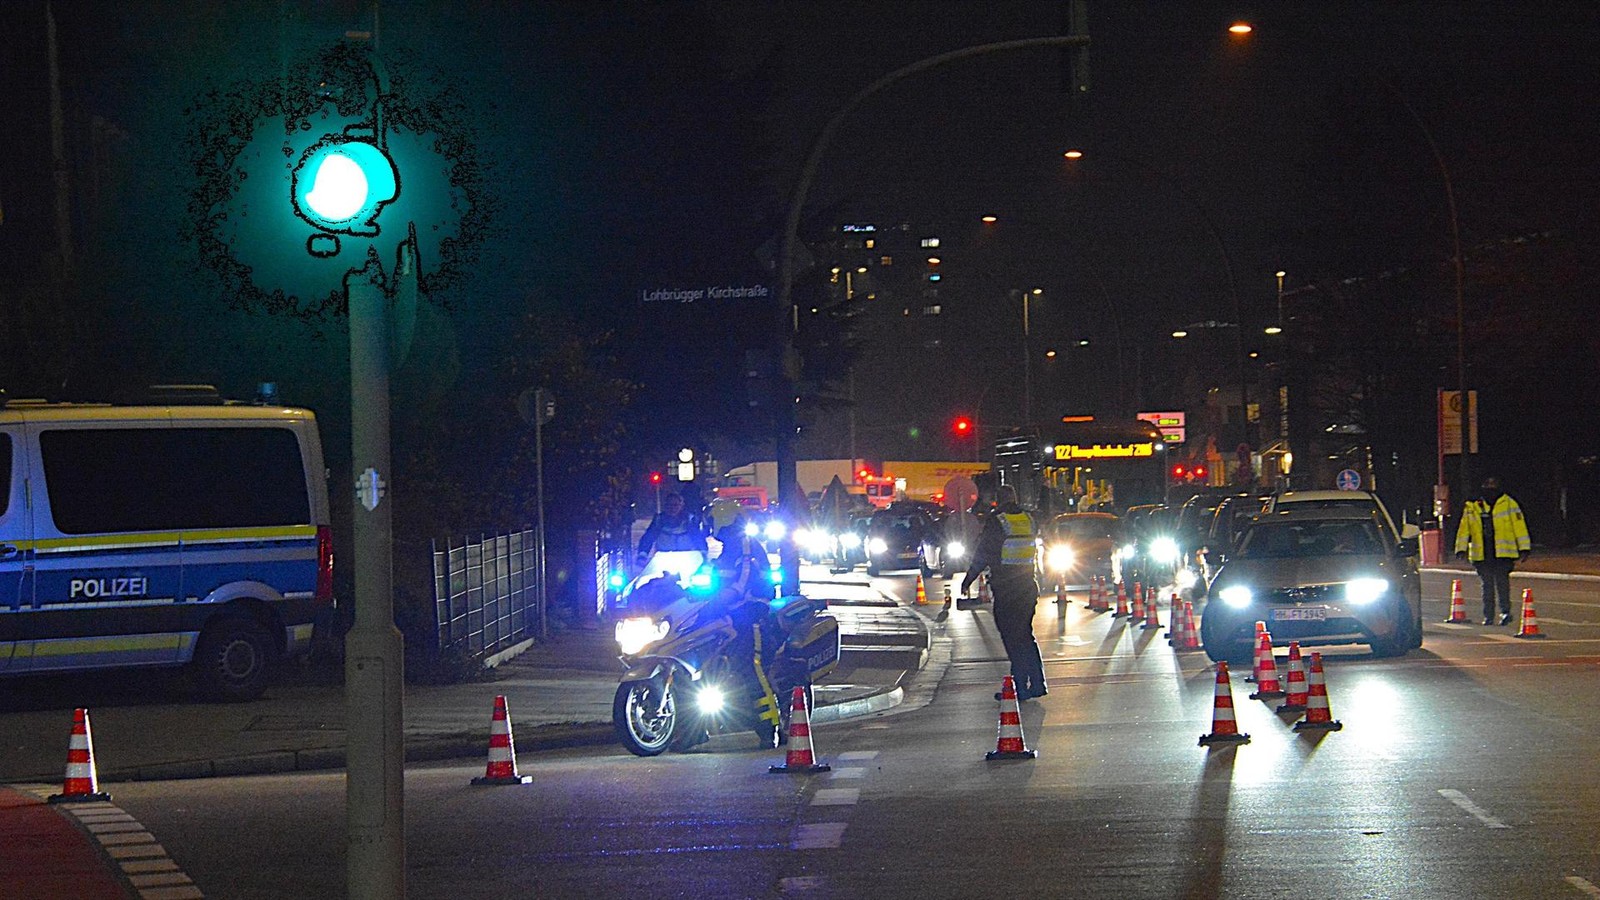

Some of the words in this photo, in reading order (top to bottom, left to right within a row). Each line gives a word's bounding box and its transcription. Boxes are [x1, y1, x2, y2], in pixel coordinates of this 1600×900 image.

[643, 287, 704, 303] Lohbrügger
[707, 284, 768, 299] Kirchstraße
[1054, 445, 1071, 460] 122
[70, 577, 147, 598] POLIZEI
[808, 646, 836, 670] POLIZEI
